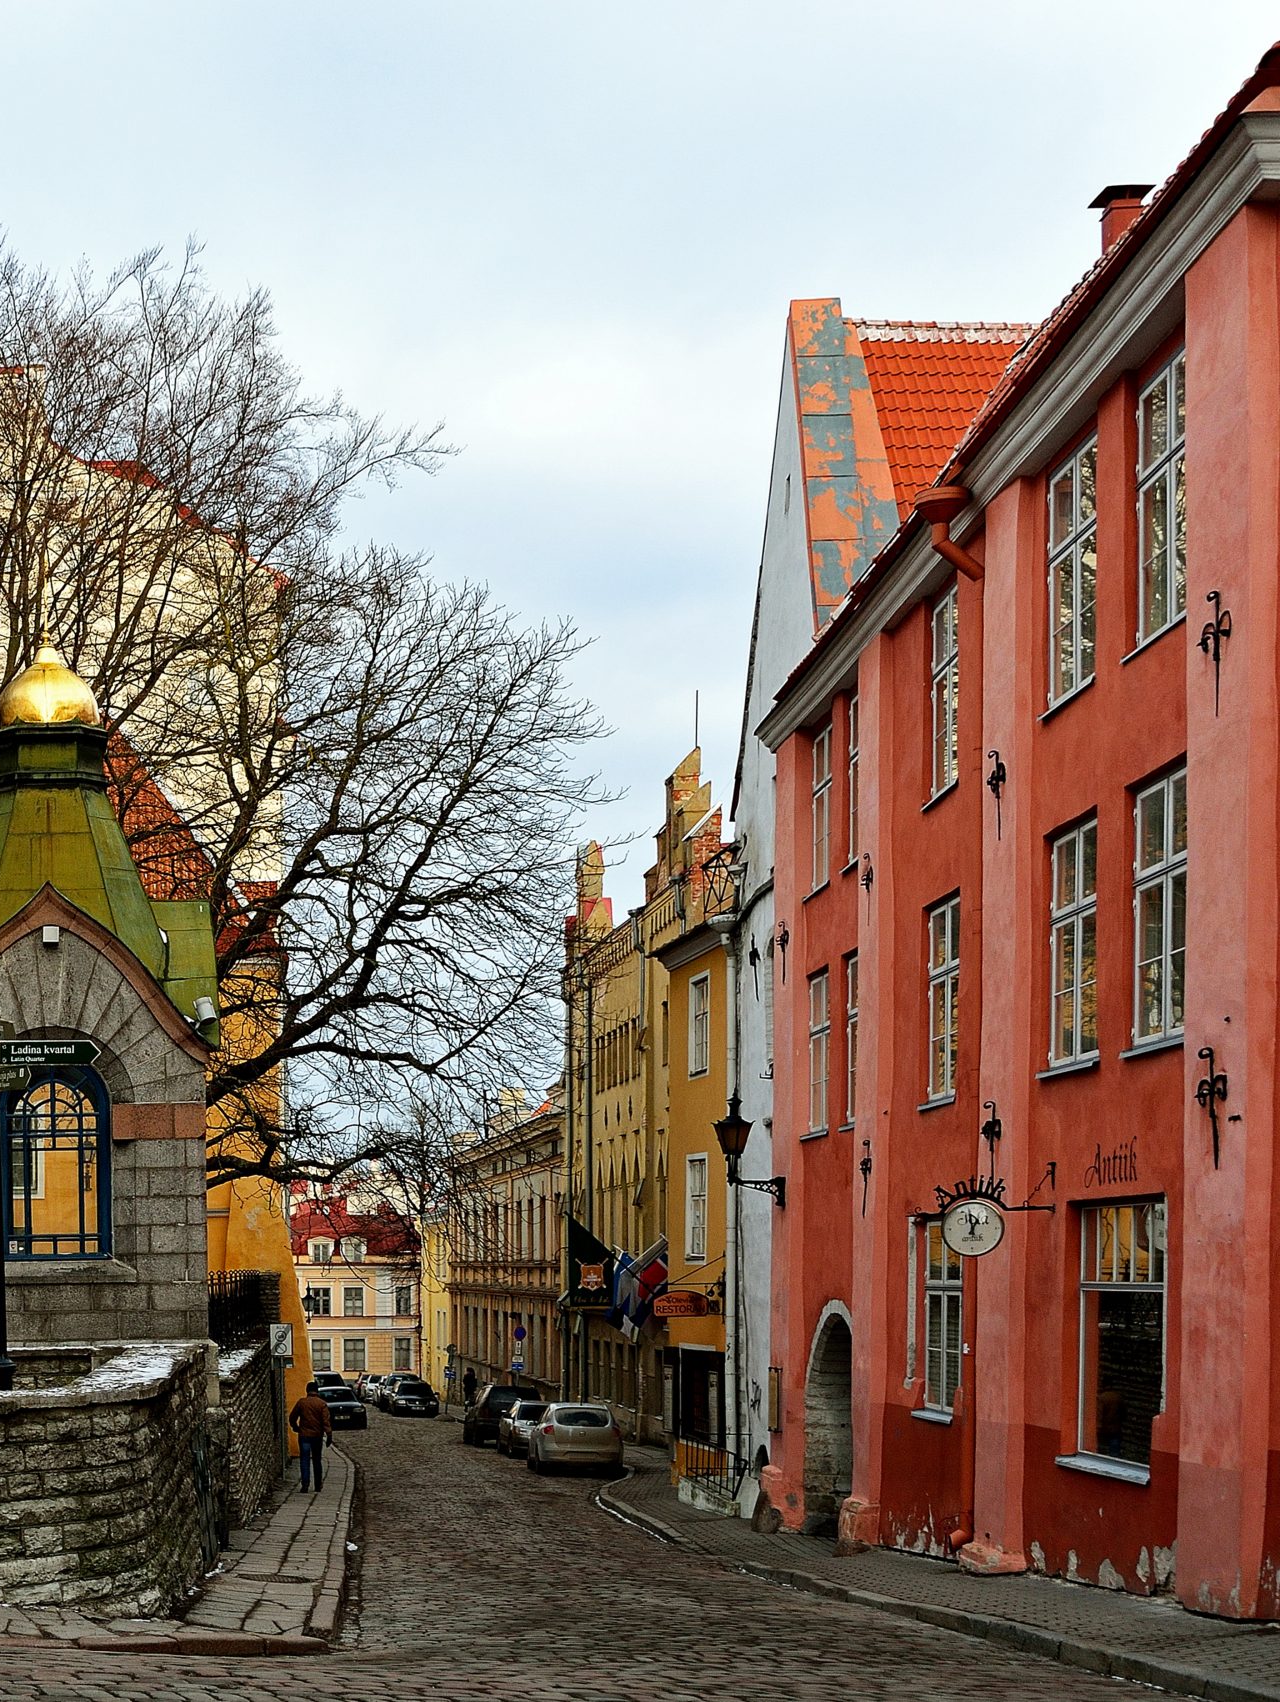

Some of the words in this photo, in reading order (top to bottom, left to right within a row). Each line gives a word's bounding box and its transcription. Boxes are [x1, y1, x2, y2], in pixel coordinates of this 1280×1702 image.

[11, 1045, 42, 1055] Ladina
[44, 1045, 75, 1055] kvartal
[1084, 1136, 1137, 1188] Antiik
[933, 1174, 1006, 1209] Antiik
